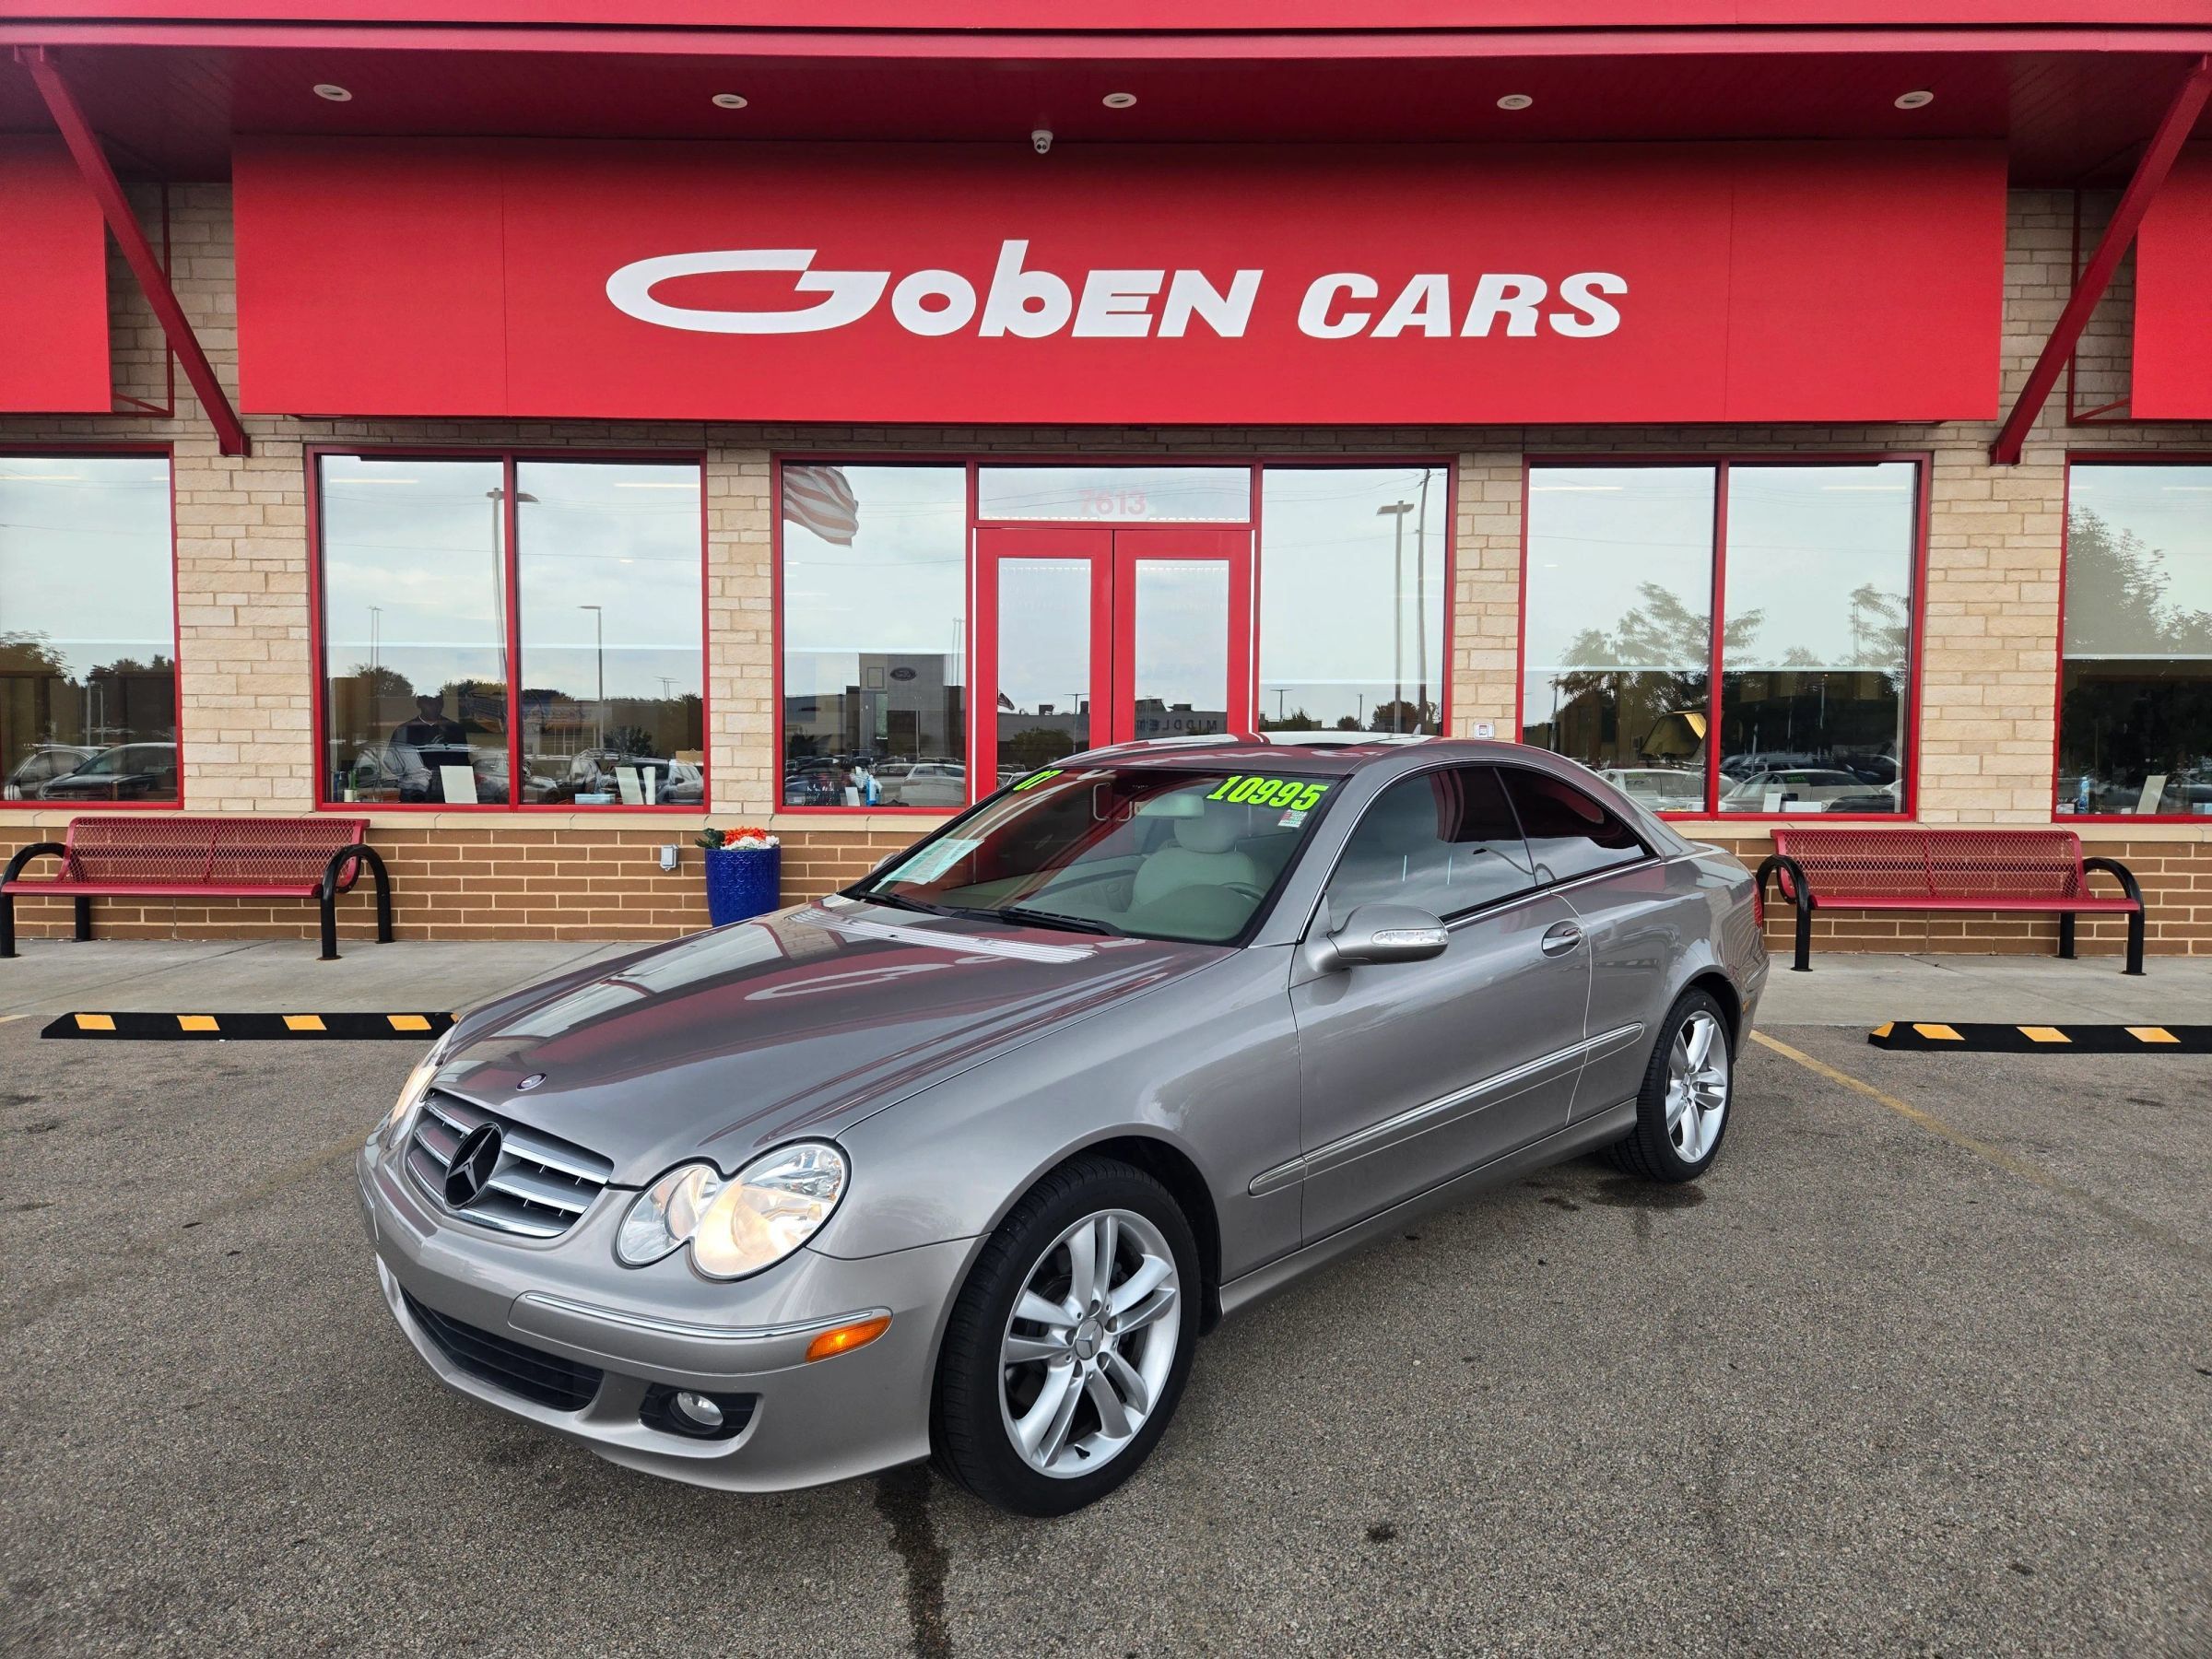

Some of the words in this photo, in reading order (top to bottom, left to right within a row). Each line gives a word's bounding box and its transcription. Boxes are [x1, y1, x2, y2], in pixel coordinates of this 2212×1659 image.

[1297, 273, 1629, 339] CARS
[1077, 488, 1147, 515] 7613
[1206, 776, 1329, 811] 10995
